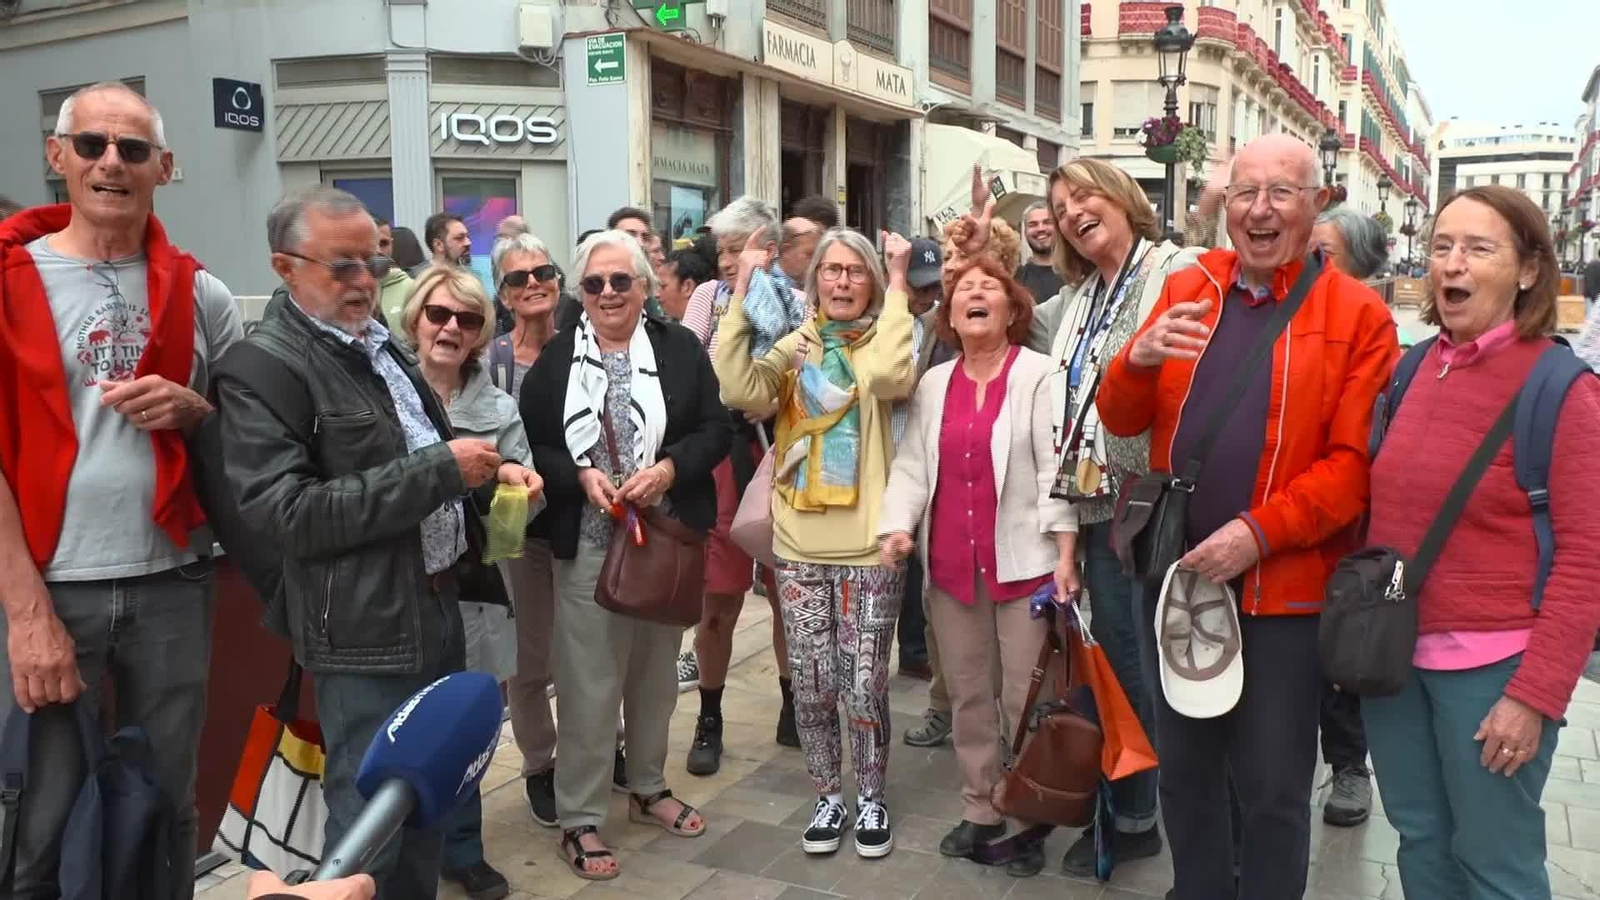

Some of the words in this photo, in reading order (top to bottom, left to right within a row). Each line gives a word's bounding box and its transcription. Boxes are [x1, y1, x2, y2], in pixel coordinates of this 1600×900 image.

[767, 30, 816, 69] FARMACIA
[876, 68, 907, 96] MATA
[225, 112, 260, 127] IQOS
[440, 112, 558, 146] IQOS
[653, 156, 687, 174] RMACIA
[77, 315, 96, 350] MOTHER
[94, 345, 117, 360] IT'S
[91, 360, 111, 375] TO
